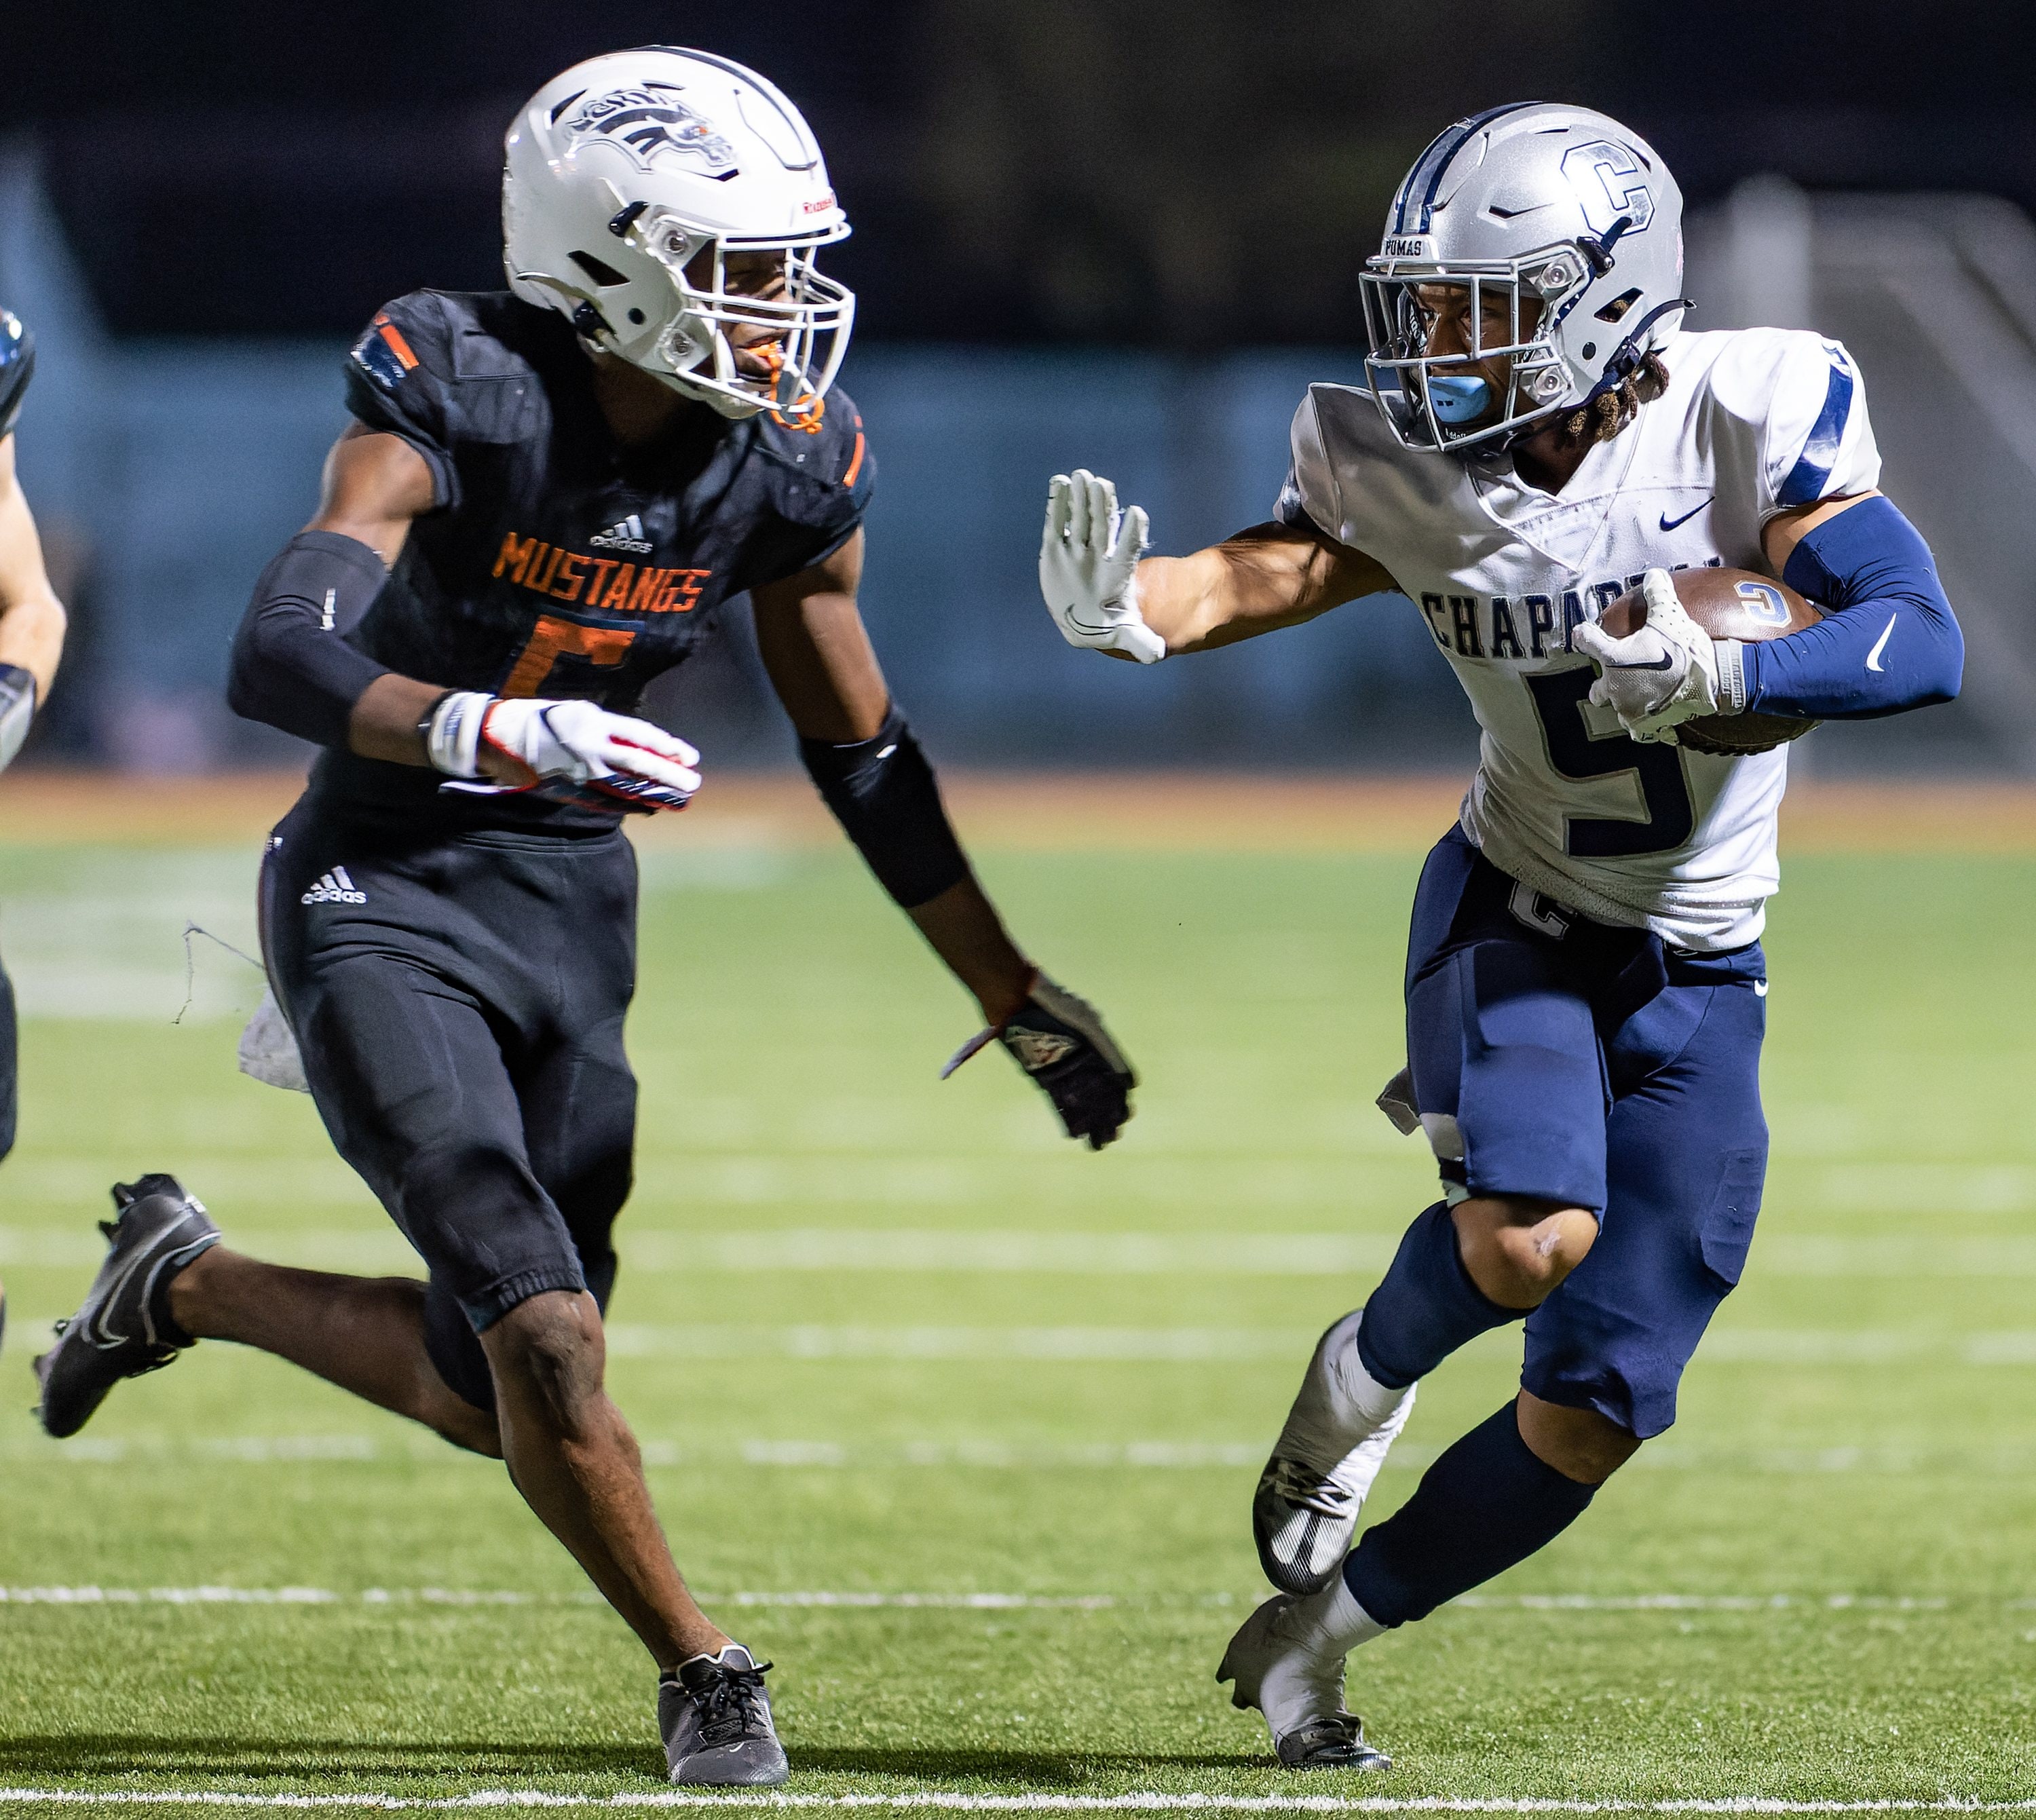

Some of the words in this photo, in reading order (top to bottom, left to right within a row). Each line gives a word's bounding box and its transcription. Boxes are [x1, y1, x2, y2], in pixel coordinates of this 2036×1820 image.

[1560, 139, 1655, 238] C
[1385, 240, 1422, 256] PUMAS
[491, 531, 712, 612] MUSTANGS
[1421, 556, 1720, 658] CHAPA
[1520, 665, 1696, 859] 5
[301, 888, 366, 905] adidas
